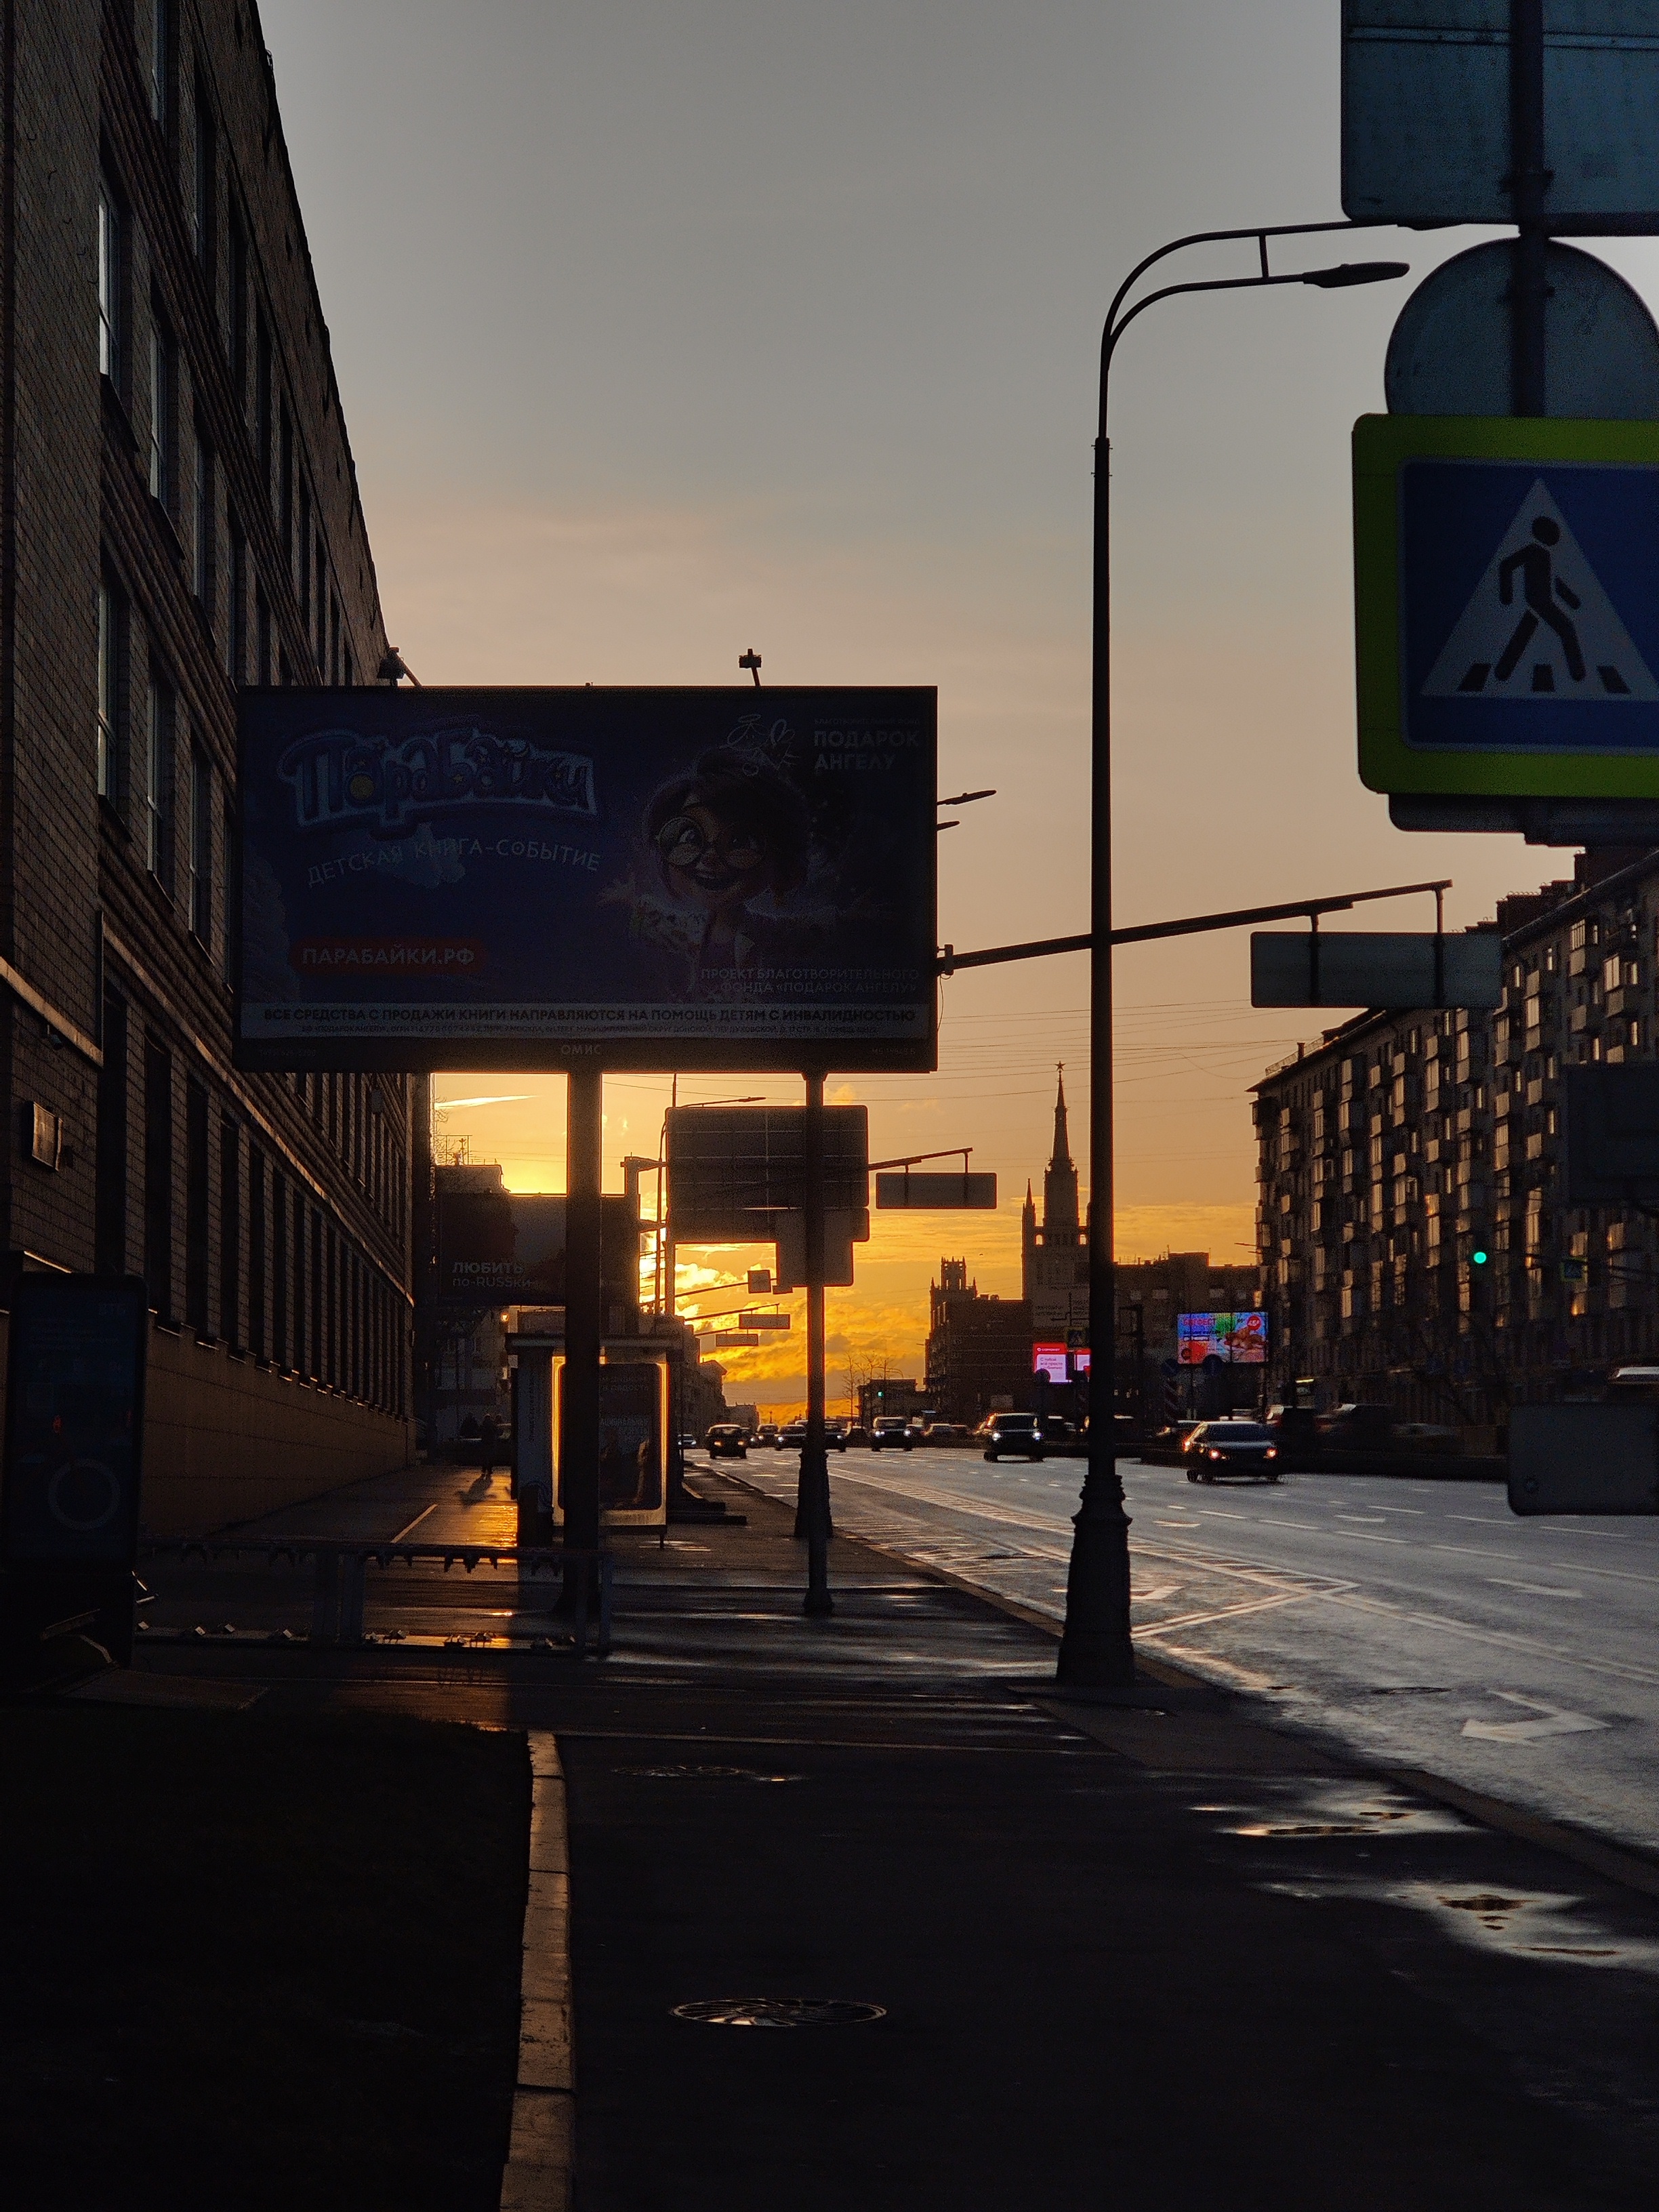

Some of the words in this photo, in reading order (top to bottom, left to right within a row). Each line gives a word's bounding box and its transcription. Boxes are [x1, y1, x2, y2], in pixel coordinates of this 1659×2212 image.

[814, 730, 920, 748] ПОДАРОК
[814, 754, 896, 770] АНГЕЛУ
[307, 846, 403, 888] ДЕТСКАЯ
[415, 838, 602, 872] КНИГА-СОБЫТИЕ
[302, 943, 475, 964] ПАРАБАЙКИ.РФ
[701, 968, 758, 979] ПРОЕКТ
[758, 968, 920, 980] БЛАГОТВОРИТЕЛЬНОГО
[720, 982, 774, 994] ФОНДА
[777, 982, 850, 994] «ПОДАРОК
[264, 1008, 290, 1021] ВСЕ
[293, 1008, 366, 1021] СРЕДСТВА
[369, 1008, 380, 1021] С
[383, 1008, 455, 1021] ПРОДАЖИ
[459, 1008, 506, 1021] КНИГИ
[510, 1008, 624, 1021] НАПРАВЛЯЮТСЯ
[629, 1008, 648, 1021] НА
[651, 1008, 716, 1021] ПОМОЩЬ
[720, 1008, 765, 1021] ДЕТЯМ
[769, 1008, 779, 1021] С
[783, 1008, 916, 1021] ИНВАЛИДНОСТЬЮ
[560, 1044, 602, 1054] ОМИС
[452, 1262, 525, 1273] ЛЮБИТЬ
